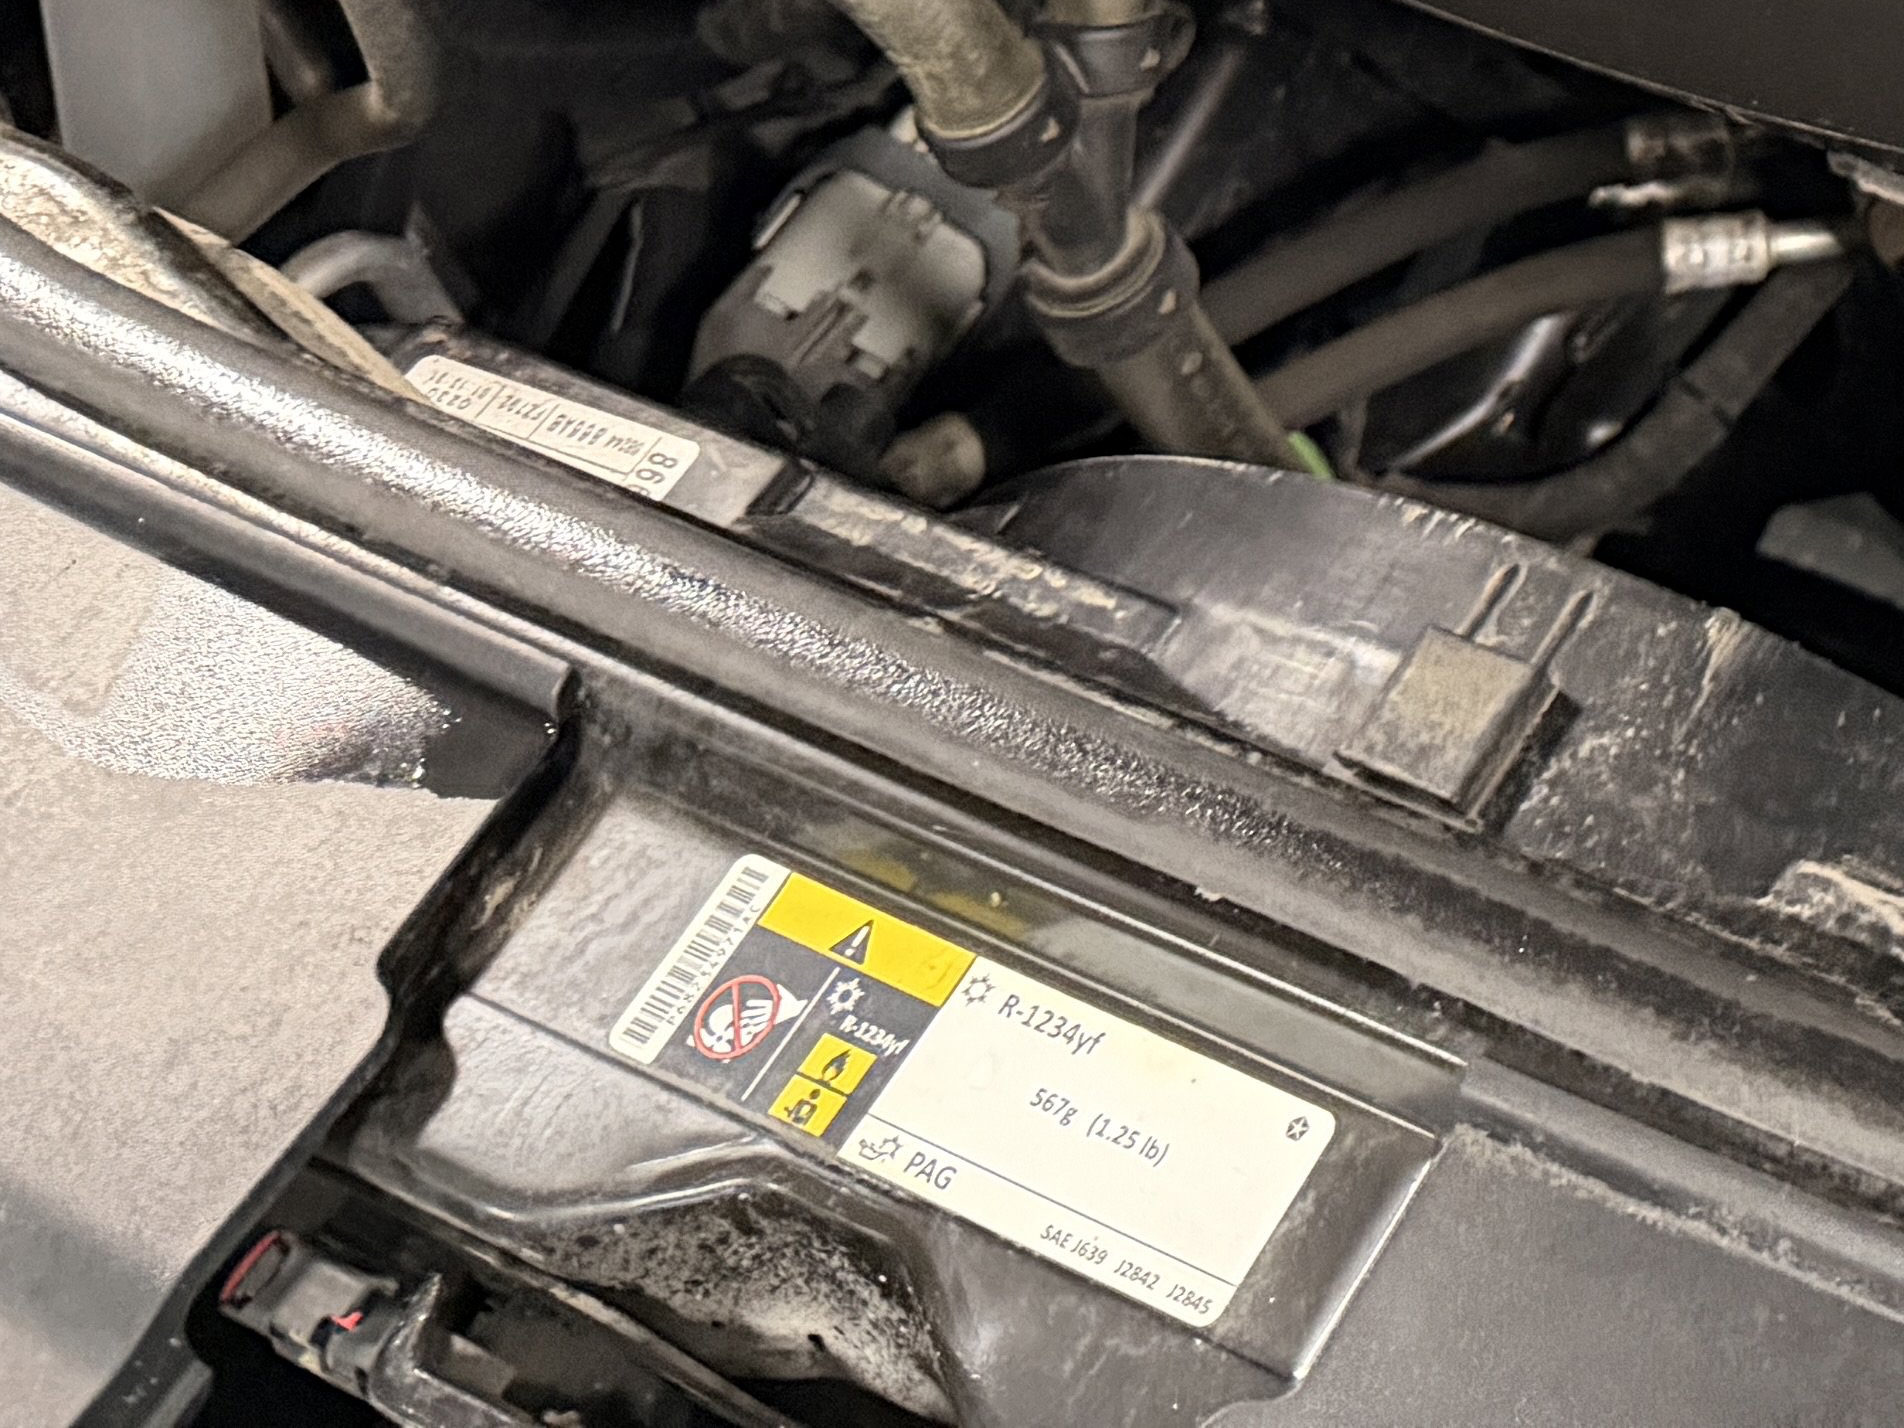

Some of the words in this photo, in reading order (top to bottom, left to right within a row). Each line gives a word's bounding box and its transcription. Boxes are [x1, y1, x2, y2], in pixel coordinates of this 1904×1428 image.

[838, 1013, 911, 1056] R-1234yf
[998, 994, 1107, 1056] R-1234yf
[1029, 1087, 1079, 1127] 567g
[1086, 1113, 1141, 1150] (1.25
[1139, 1136, 1171, 1168] lb)
[903, 1150, 958, 1191] PAG
[1040, 1224, 1073, 1249] SAE
[1070, 1239, 1109, 1266] J639
[1113, 1259, 1162, 1291] J2842
[1166, 1284, 1215, 1315] J2845
